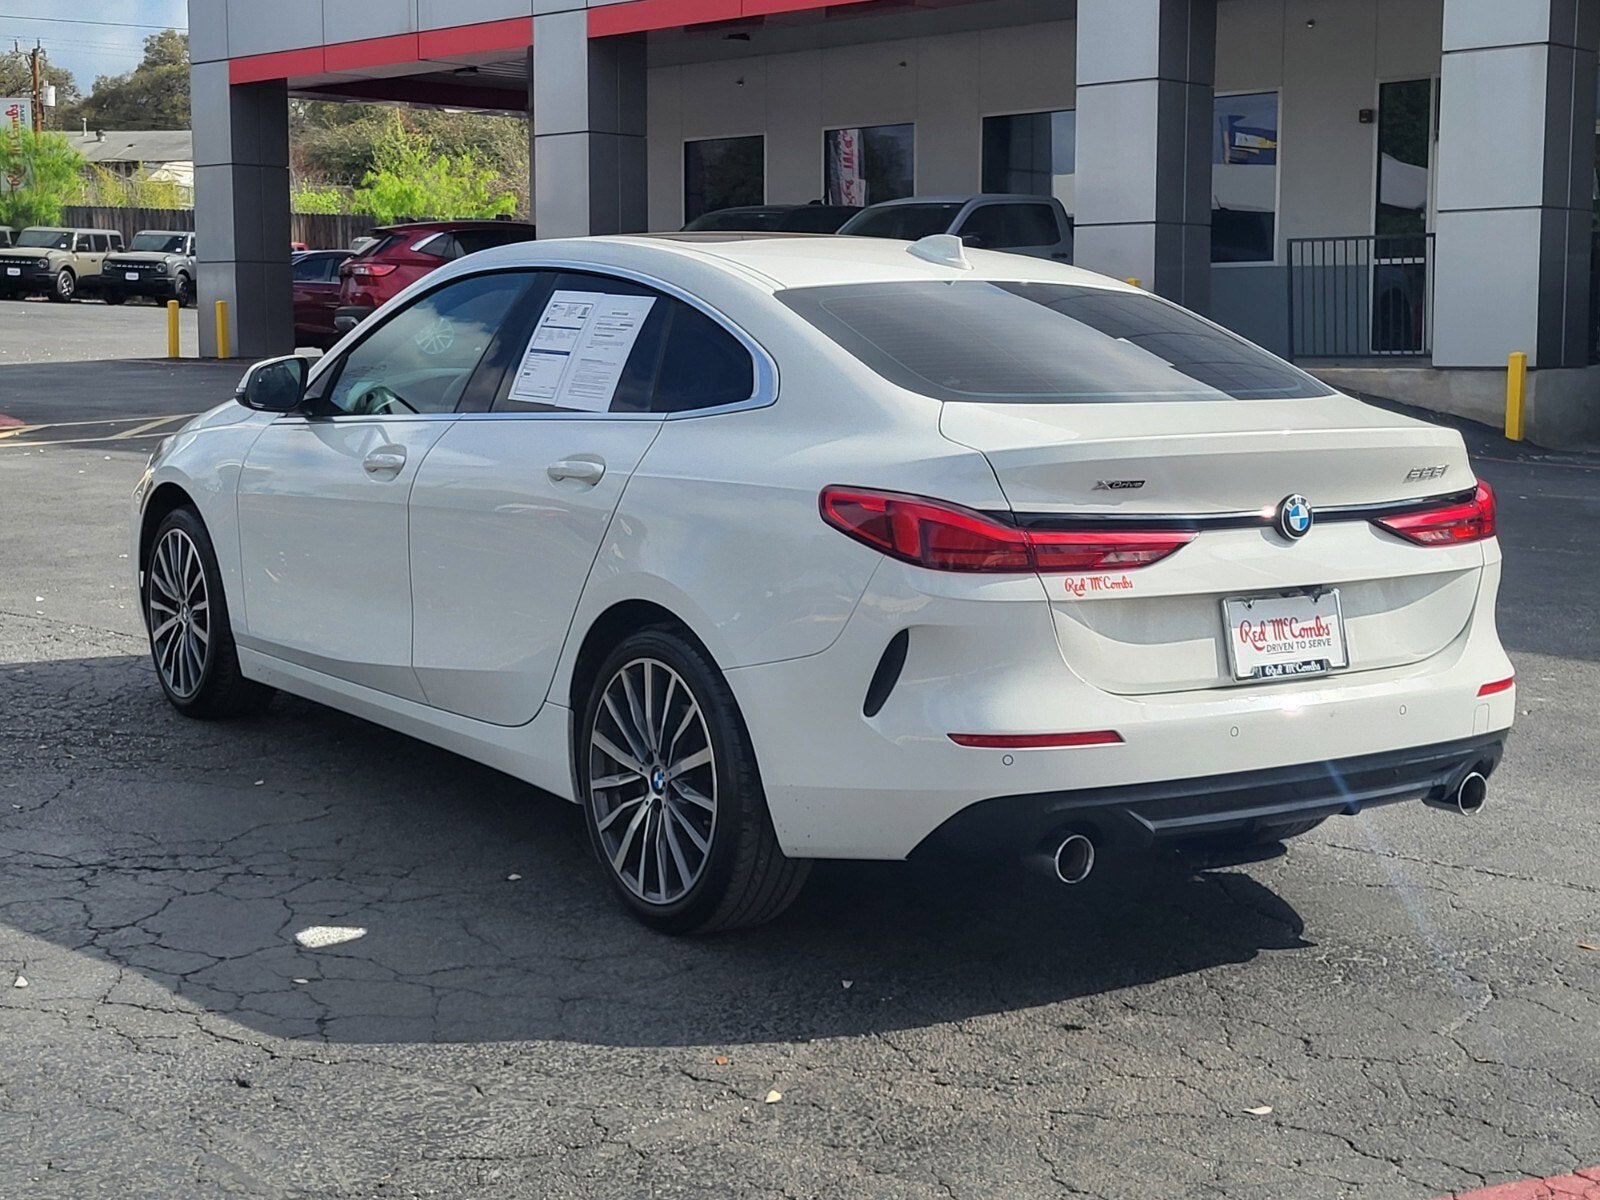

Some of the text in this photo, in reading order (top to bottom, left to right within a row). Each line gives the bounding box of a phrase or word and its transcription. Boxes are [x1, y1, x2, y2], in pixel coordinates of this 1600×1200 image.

[1064, 575, 1134, 597] Red McCombs
[1239, 615, 1331, 651] Red McCombs
[1266, 637, 1332, 653] DRIVEN TO SERVE
[1265, 660, 1321, 677] Red McCombs
